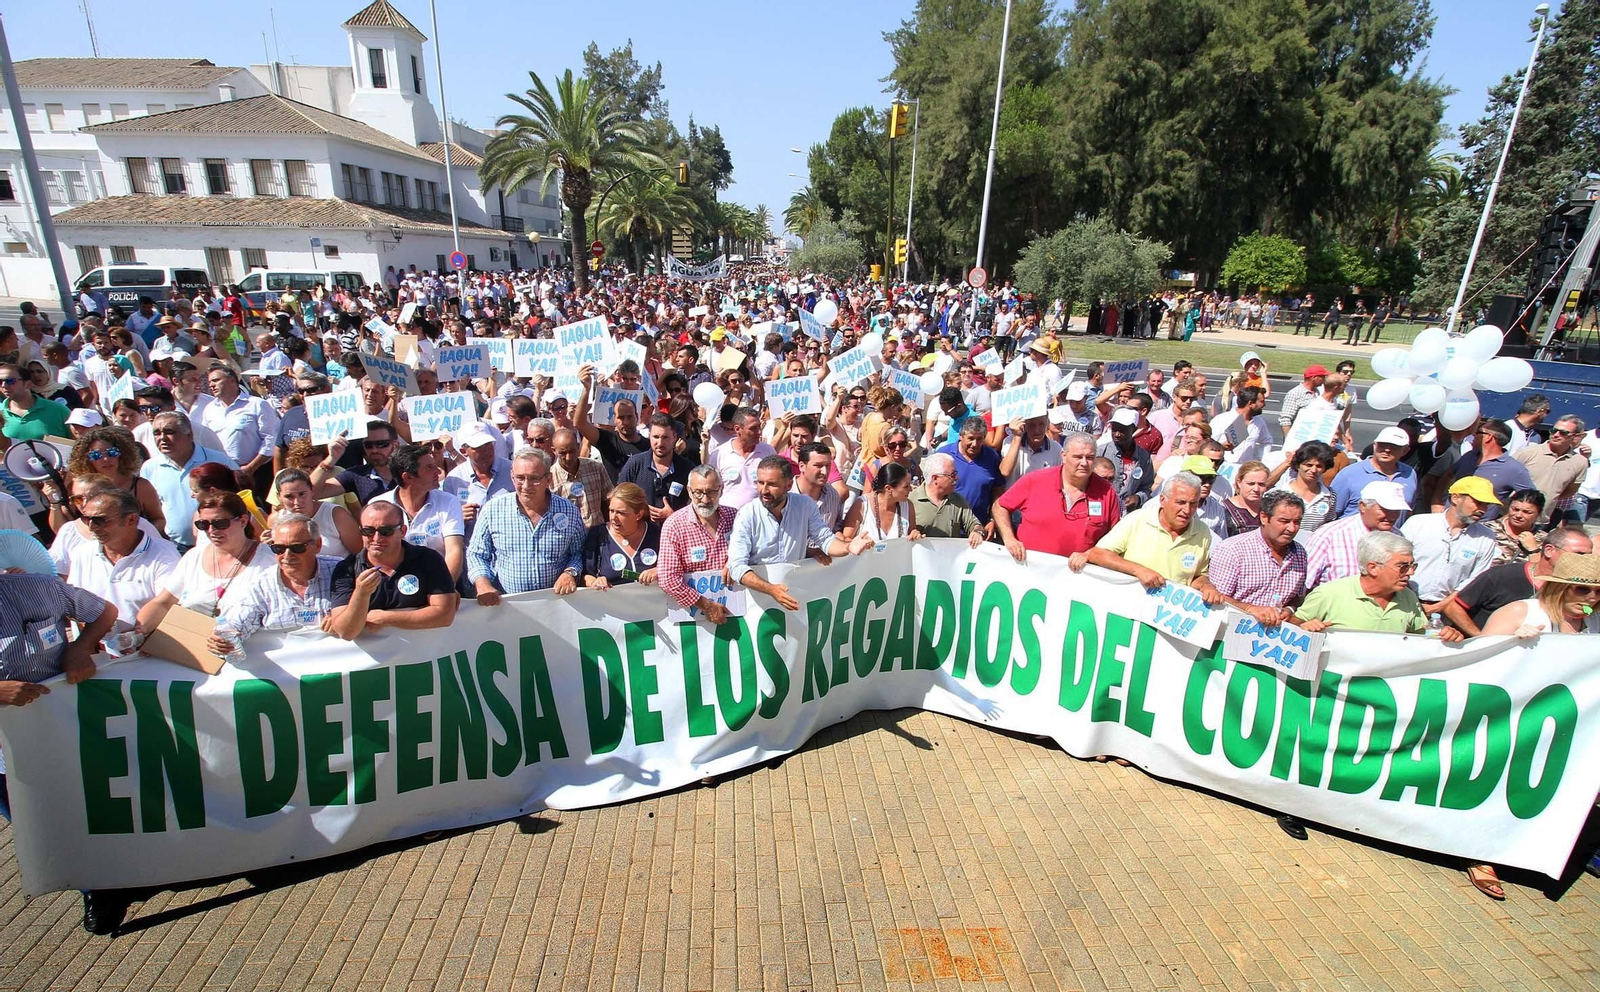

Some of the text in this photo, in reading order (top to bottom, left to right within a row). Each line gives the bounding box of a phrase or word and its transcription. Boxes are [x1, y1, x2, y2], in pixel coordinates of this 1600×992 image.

[670, 264, 702, 276] AGUA
[440, 348, 482, 364] ¡¡AGUA
[573, 342, 603, 365] YA!!
[451, 363, 479, 378] YA!!
[847, 360, 872, 382] YA!!
[771, 379, 812, 397] ¡¡AGUA
[414, 395, 466, 416] ¡¡AGUA
[782, 395, 809, 411] YA!!
[427, 415, 462, 434] YA!!
[1152, 605, 1198, 638] YA!!
[1235, 618, 1311, 653] ¡¡AGUA
[1251, 639, 1299, 669] YA!!
[77, 562, 1578, 835] EN DEFENSA DE LOS REGADÍOS DEL CONDADO
